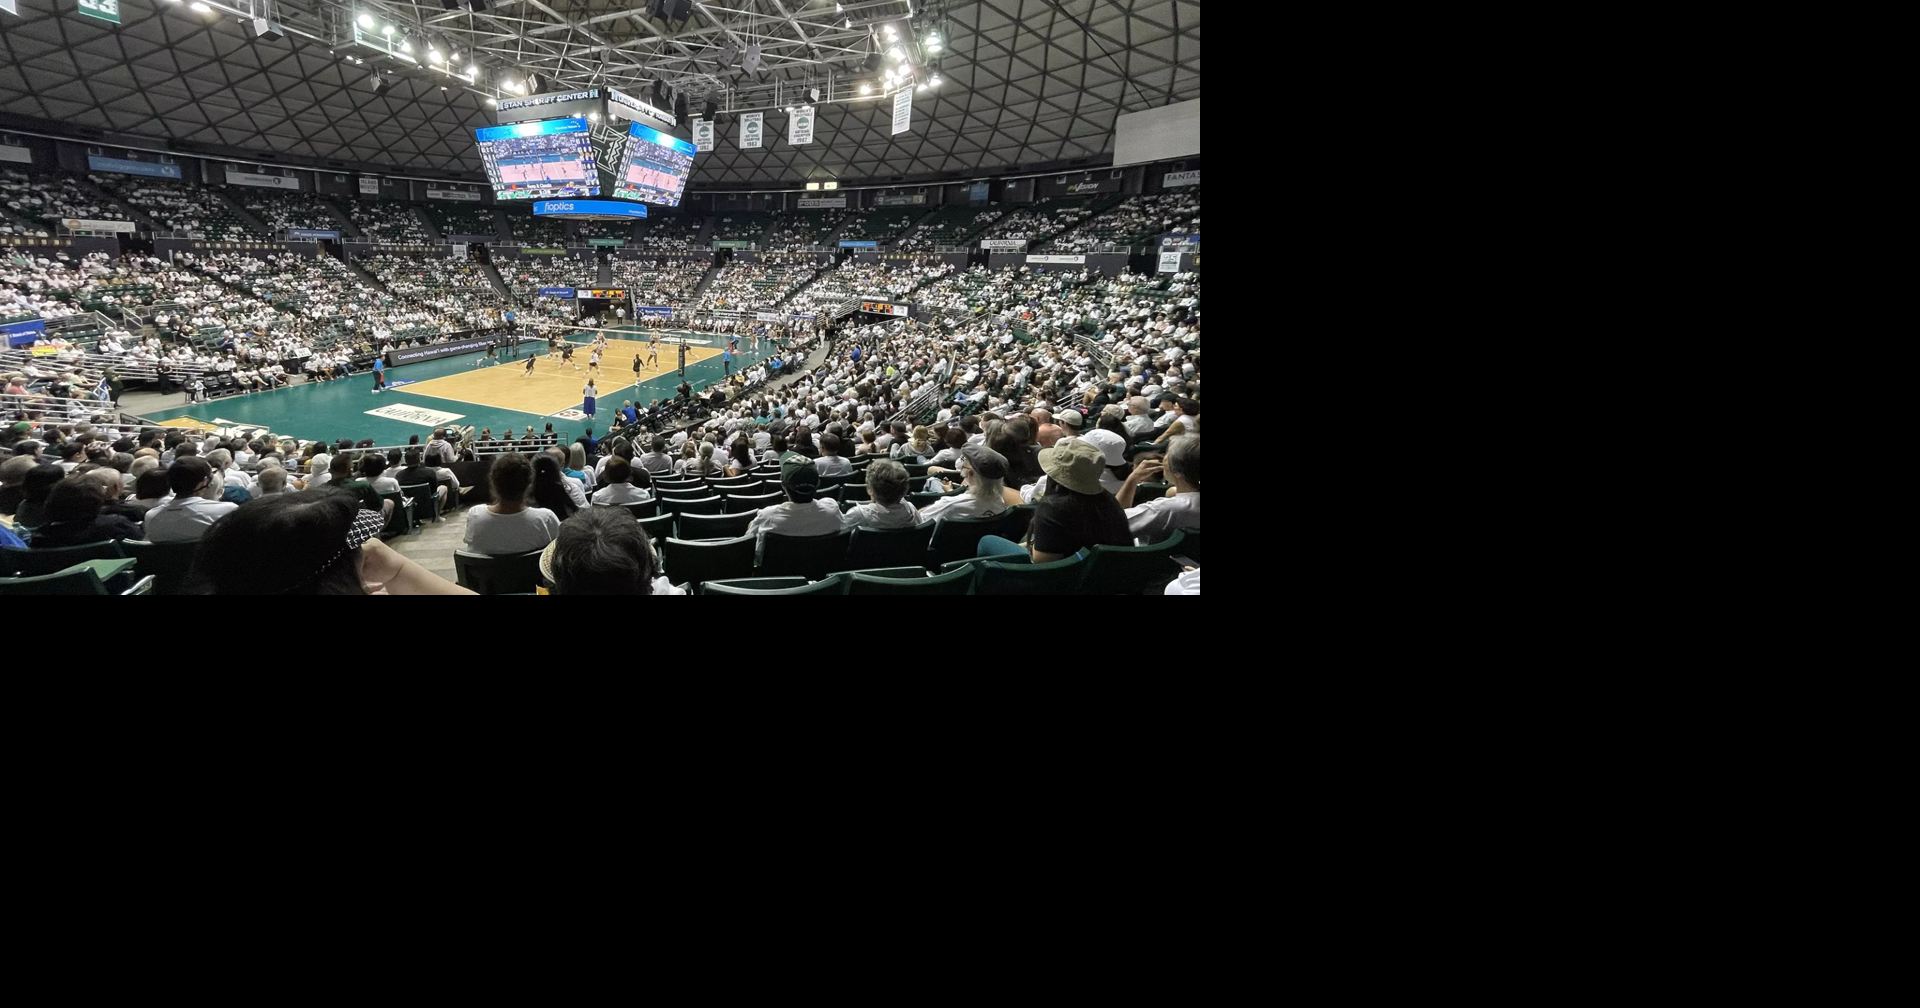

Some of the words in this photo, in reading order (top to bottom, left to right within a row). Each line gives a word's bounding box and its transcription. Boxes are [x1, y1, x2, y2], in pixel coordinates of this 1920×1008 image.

[504, 100, 523, 109] STAN
[524, 96, 556, 106] SHERIFF
[556, 91, 588, 102] CENTER
[544, 202, 574, 212] fioptics
[397, 350, 424, 360] Connecting
[449, 342, 478, 352] game-changing
